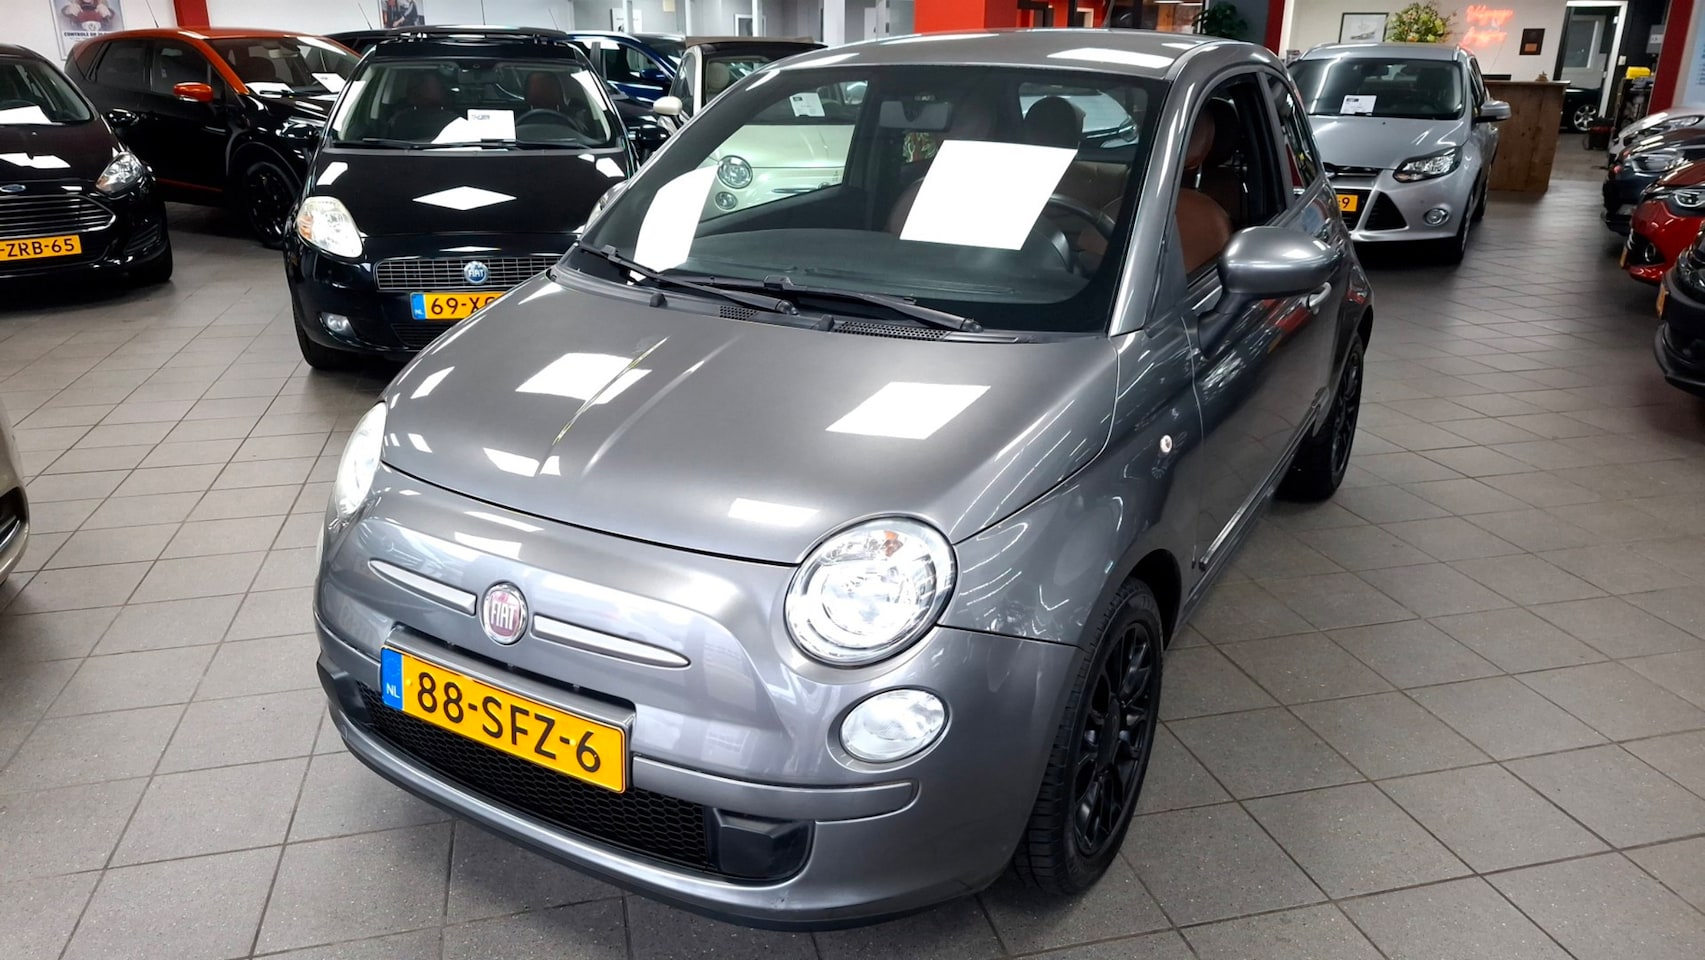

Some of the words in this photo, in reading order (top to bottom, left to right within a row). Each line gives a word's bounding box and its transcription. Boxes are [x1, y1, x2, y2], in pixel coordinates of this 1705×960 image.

[468, 269, 484, 278] FIAT
[490, 601, 517, 631] FIAT
[386, 682, 401, 700] NL
[417, 671, 602, 774] 88-SFZ-6
